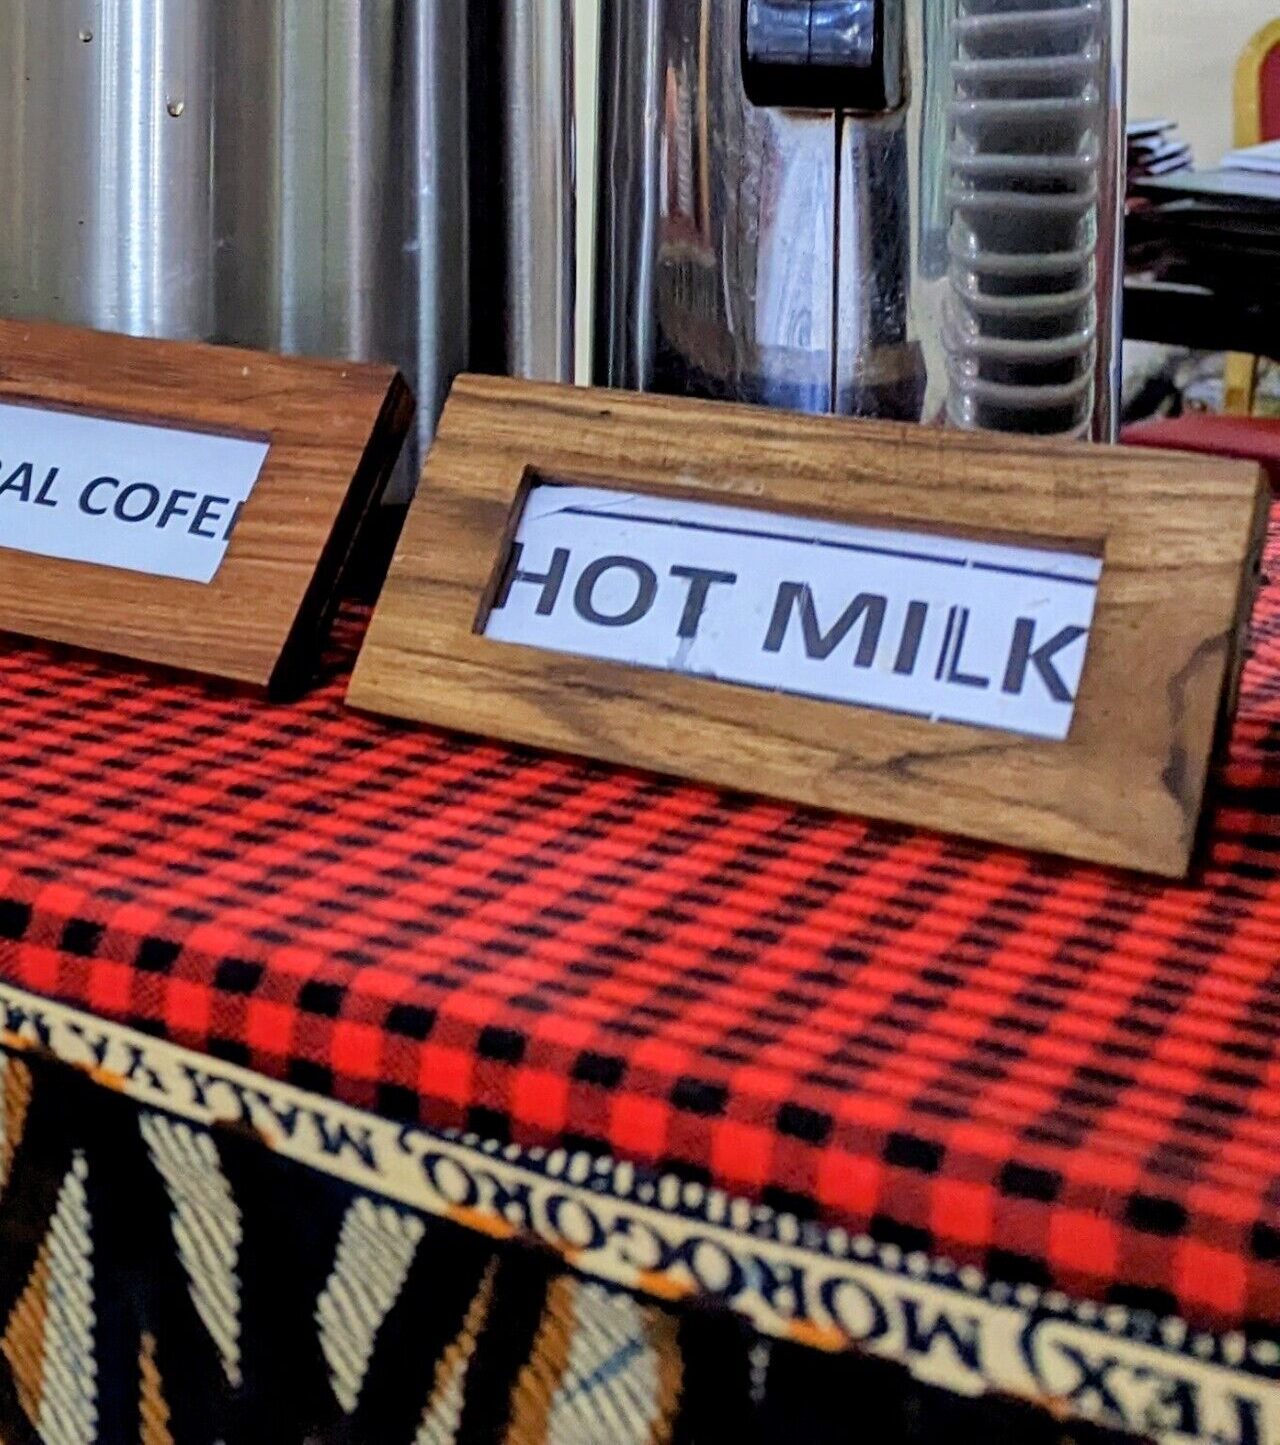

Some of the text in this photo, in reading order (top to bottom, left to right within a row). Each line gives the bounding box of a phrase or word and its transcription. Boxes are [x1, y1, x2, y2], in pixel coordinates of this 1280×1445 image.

[493, 538, 1089, 704] HOT MILK
[179, 1060, 385, 1176] MALI
[399, 1127, 984, 1372] MOROGORO,
